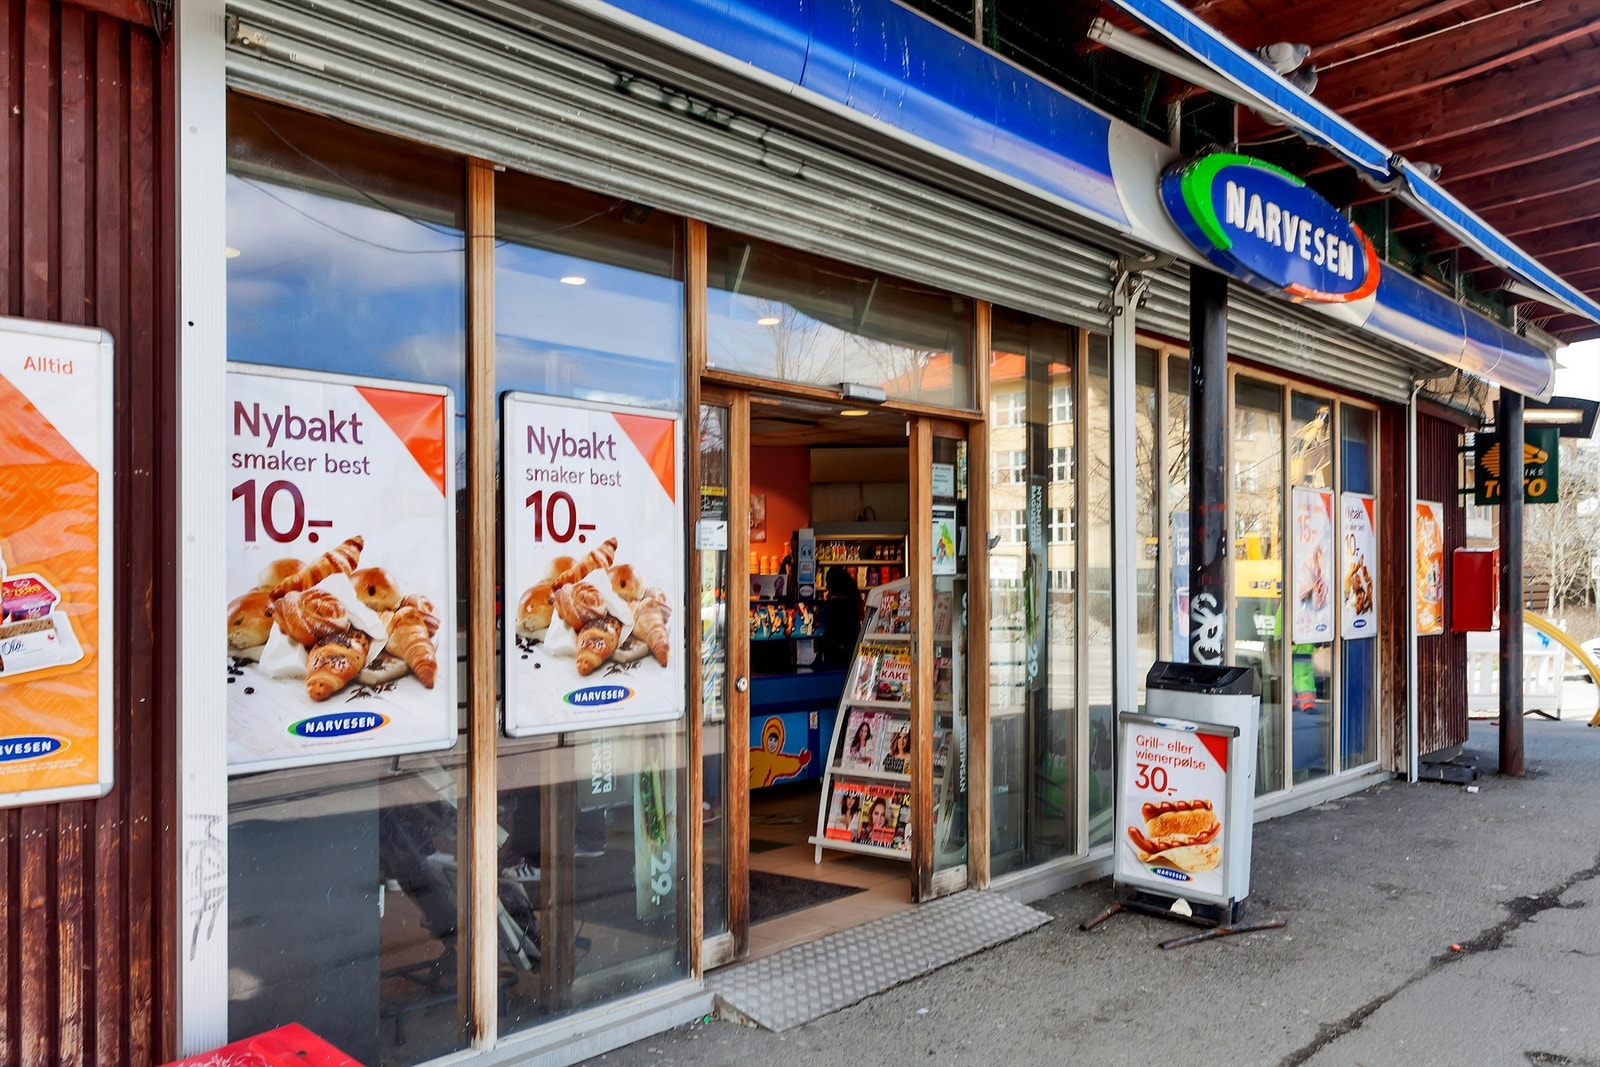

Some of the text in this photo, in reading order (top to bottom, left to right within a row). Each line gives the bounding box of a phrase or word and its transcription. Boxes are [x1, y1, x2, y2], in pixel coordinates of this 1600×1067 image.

[1225, 180, 1354, 281] NARVESEN
[23, 355, 73, 375] Alltid
[233, 400, 364, 448] Nybakt
[526, 425, 617, 464] Nybakt
[231, 450, 371, 476] smaker best
[1524, 467, 1545, 477] IKS
[525, 465, 622, 488] smaker best
[231, 478, 333, 544] 10.-
[525, 489, 597, 544] 10.-
[880, 669, 909, 681] KAKE
[574, 689, 625, 703] NARVESEN
[305, 716, 376, 734] NARVESEN
[1135, 734, 1194, 755] Grill- eller
[1135, 748, 1206, 771] wienerpølse
[1134, 762, 1178, 797] 30.-
[1156, 868, 1187, 881] NARVESEN
